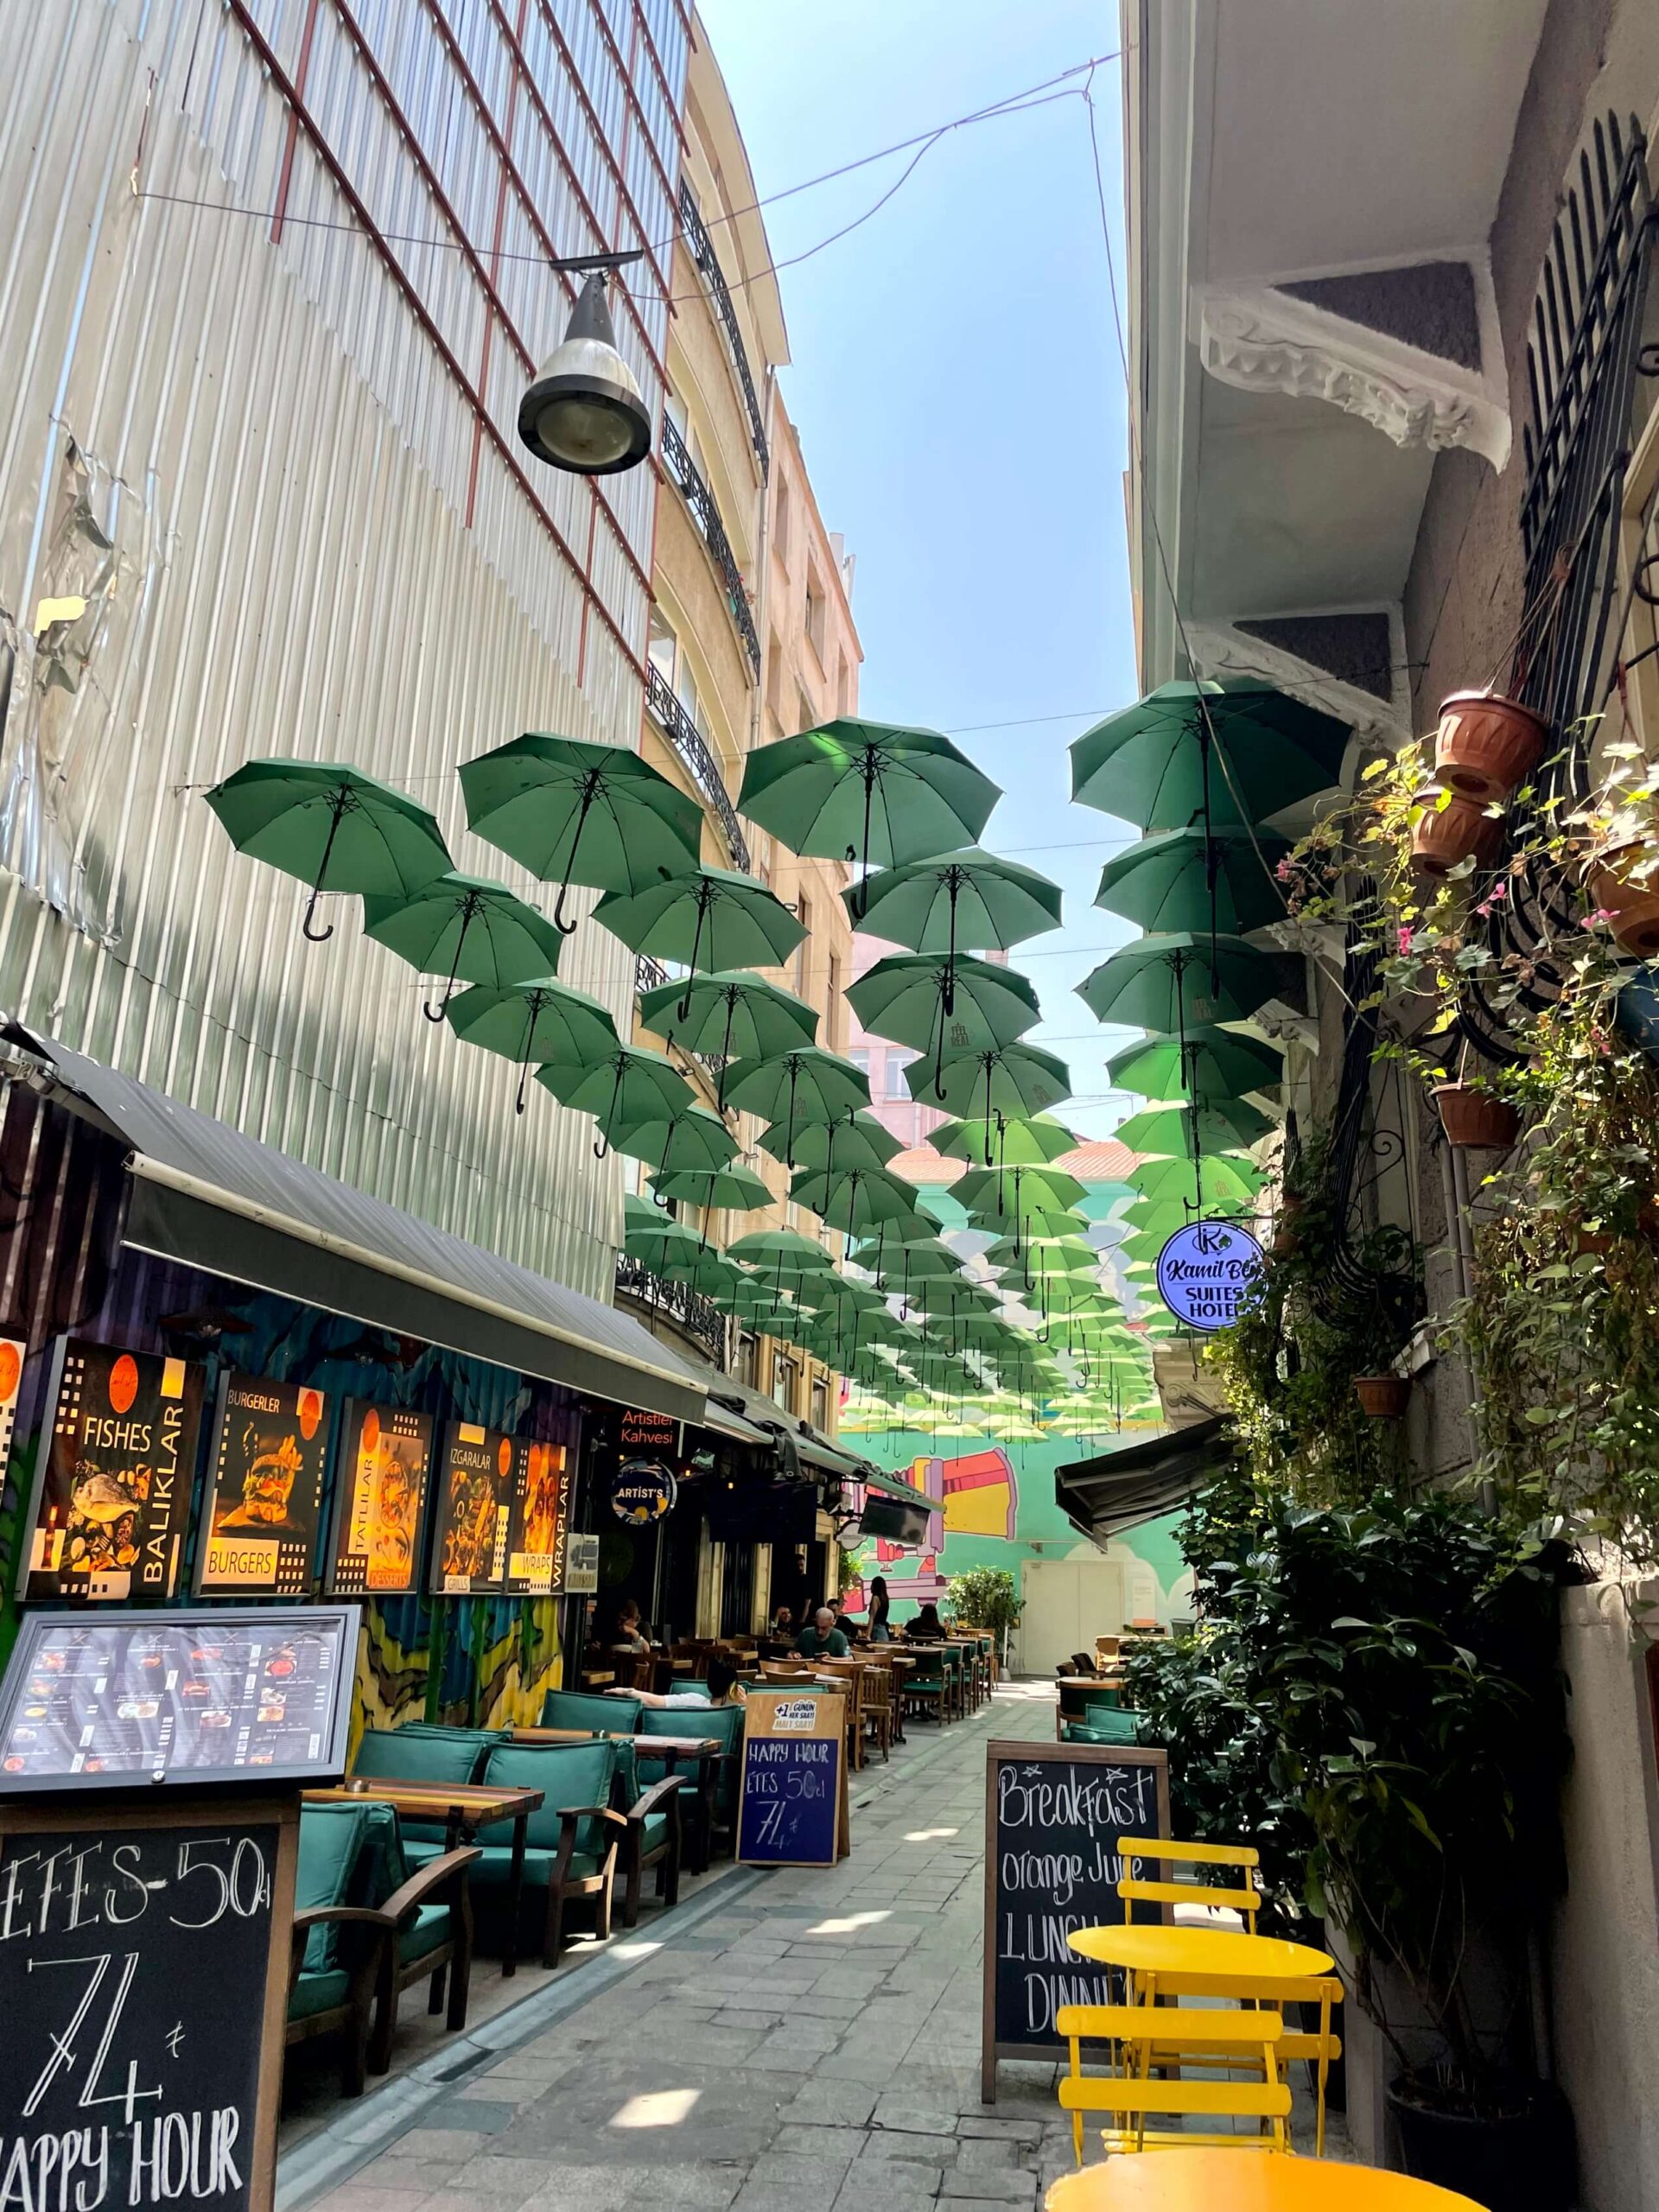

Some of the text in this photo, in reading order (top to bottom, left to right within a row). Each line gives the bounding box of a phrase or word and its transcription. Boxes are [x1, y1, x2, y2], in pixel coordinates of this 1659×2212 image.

[1166, 1259, 1262, 1284] Kamil Be
[1185, 1287, 1244, 1301] SUITES
[228, 1389, 281, 1414] BURGERLER
[84, 1416, 152, 1453] FISHES
[621, 1428, 673, 1444] Kahvesi
[449, 1447, 491, 1471] IZGARALAR
[143, 1406, 184, 1582] BALIKLAR
[355, 1459, 373, 1551] TATLILAR
[552, 1476, 569, 1588] WRAPLAR
[208, 1550, 272, 1574] BURGERS
[523, 1555, 551, 1574] WRAPS
[371, 1572, 408, 1587] DESSERTS
[448, 1578, 468, 1591] GRILLS
[776, 1704, 790, 1717] +1
[749, 1743, 830, 1764] HAPPY HOUR
[1024, 1971, 1142, 2032] DINNE
[0, 2106, 244, 2212] APPY HOUR
